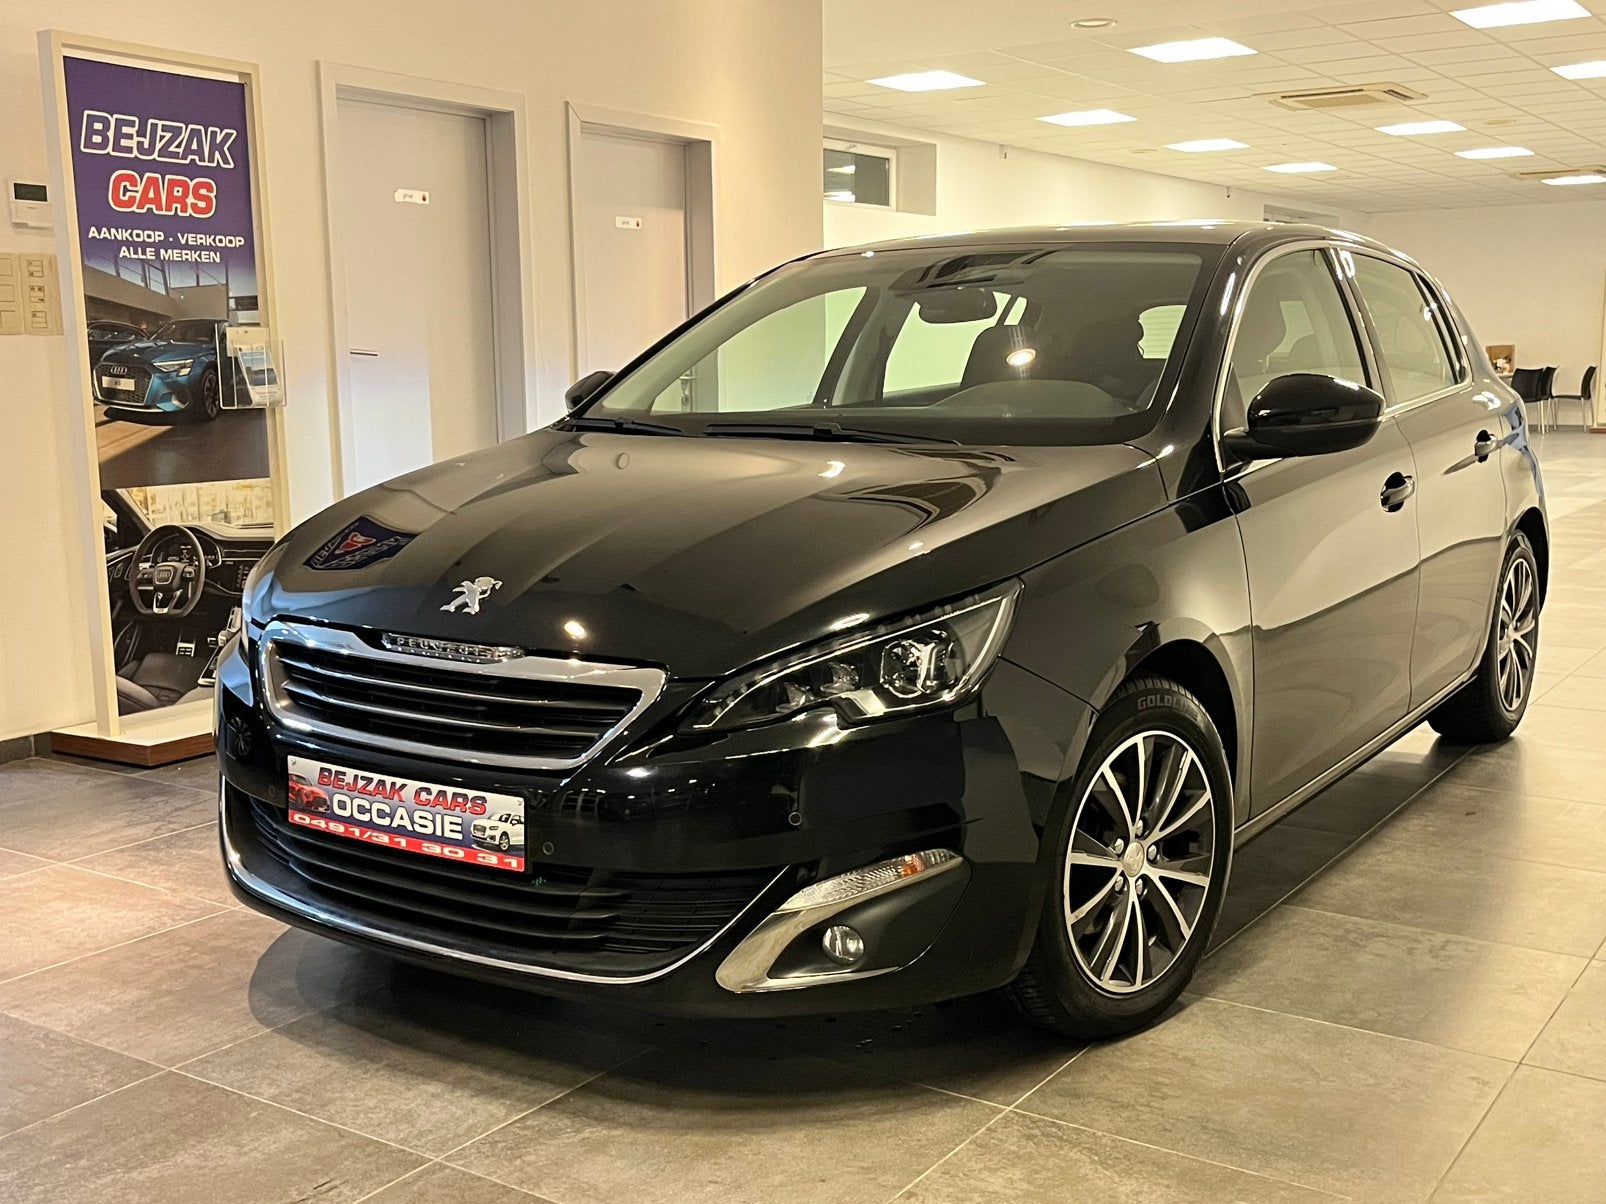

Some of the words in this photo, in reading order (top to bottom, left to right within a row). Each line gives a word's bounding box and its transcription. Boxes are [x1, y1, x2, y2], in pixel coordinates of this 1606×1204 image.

[80, 110, 237, 169] BEJZAK
[109, 170, 217, 218] CARS
[88, 226, 165, 243] AANKOOP
[177, 232, 245, 248] VERKOOP
[119, 246, 156, 260] ALLE
[160, 248, 221, 263] MERKEN
[317, 766, 408, 803] BEJZAK
[413, 786, 488, 816] CARS
[293, 813, 407, 848] 0491/31
[421, 843, 465, 859] 30
[476, 852, 518, 868] 31
[332, 793, 464, 841] OCCASIE
